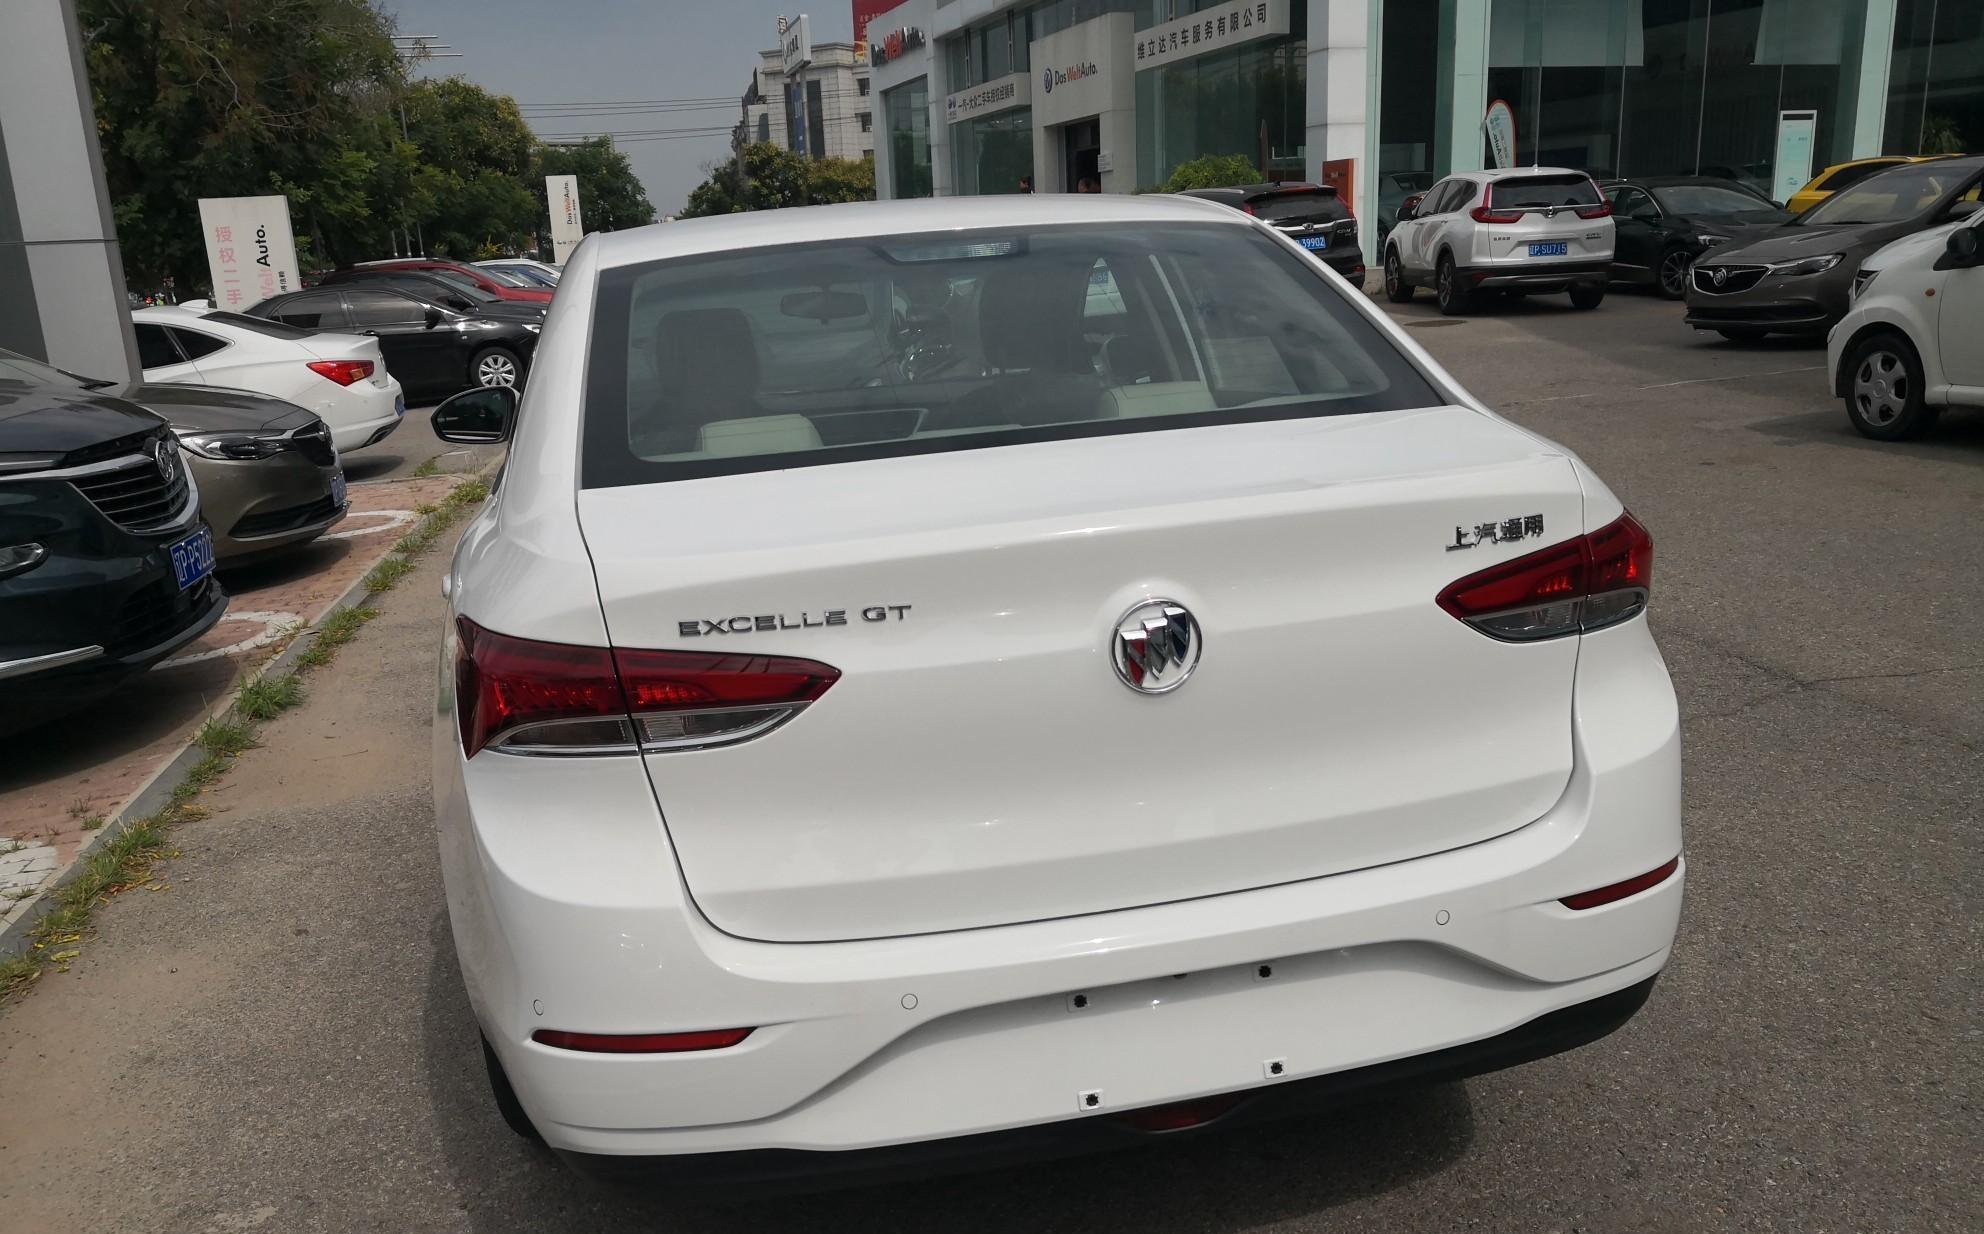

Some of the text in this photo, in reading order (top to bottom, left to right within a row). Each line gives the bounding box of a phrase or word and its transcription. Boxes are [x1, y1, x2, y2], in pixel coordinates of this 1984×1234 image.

[1137, 3, 1267, 60] 维立达汽车服务有限公司
[1445, 514, 1544, 552] 上汽通用
[679, 605, 912, 637] EXCELLE GT
